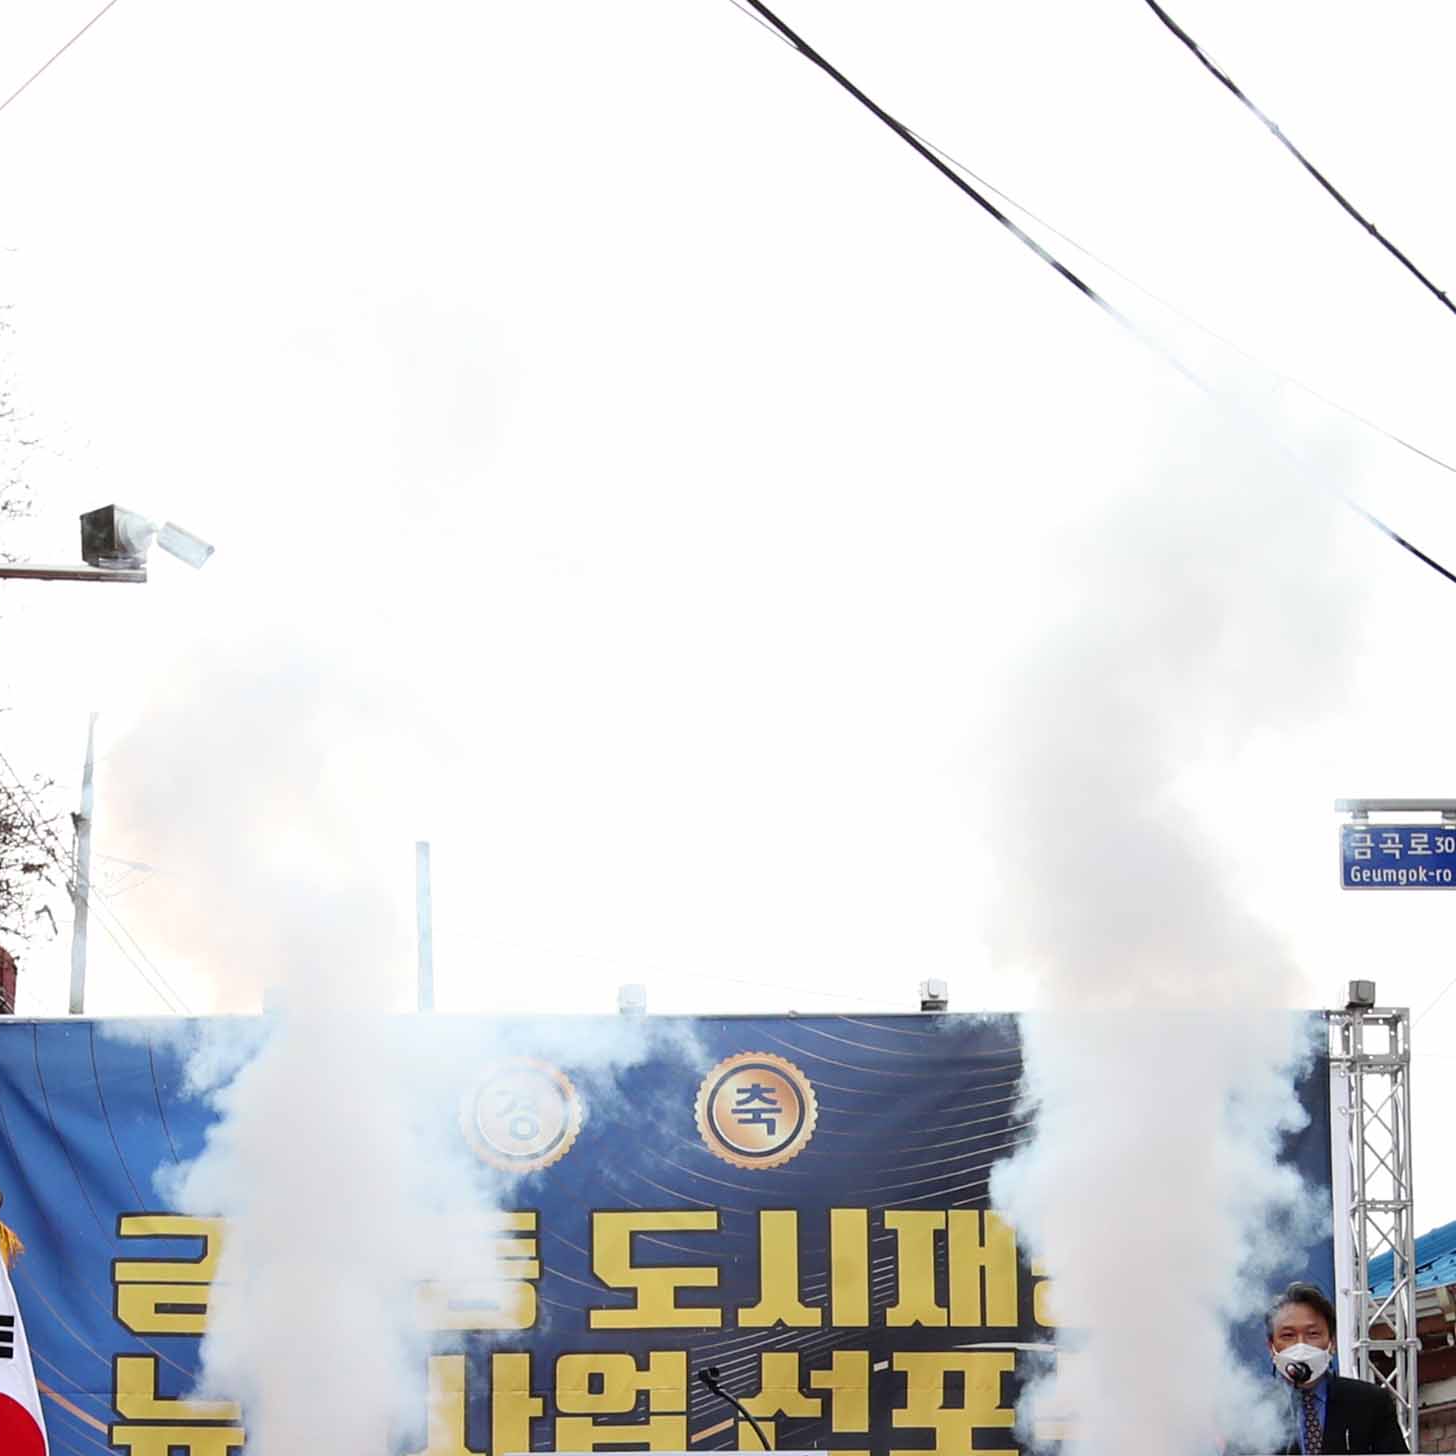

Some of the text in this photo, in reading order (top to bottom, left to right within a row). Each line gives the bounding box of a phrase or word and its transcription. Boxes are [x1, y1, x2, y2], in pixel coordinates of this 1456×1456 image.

[1350, 866, 1452, 884] Geumgok-ro
[731, 1082, 784, 1137] 축
[589, 1209, 1061, 1330] 도시재
